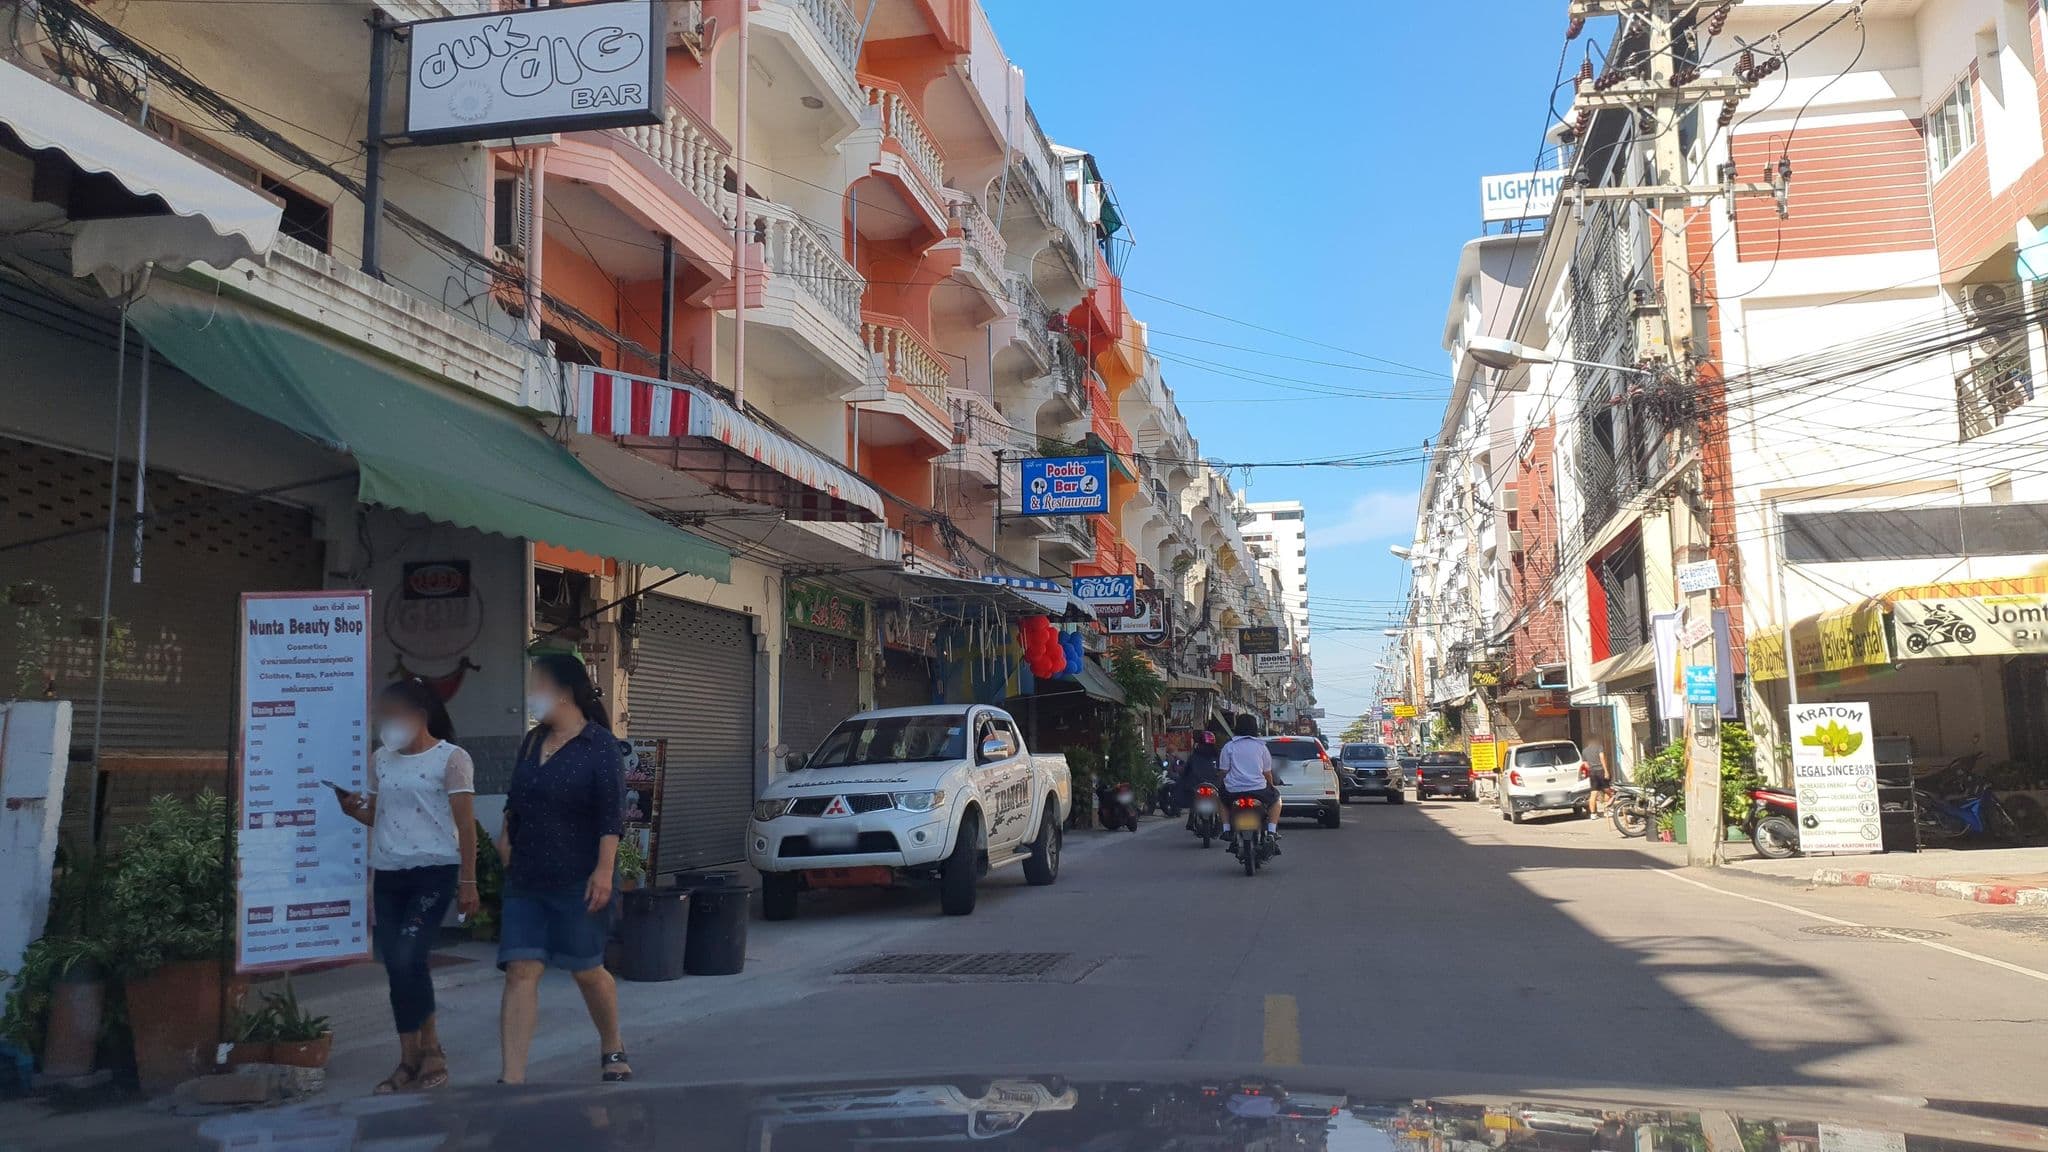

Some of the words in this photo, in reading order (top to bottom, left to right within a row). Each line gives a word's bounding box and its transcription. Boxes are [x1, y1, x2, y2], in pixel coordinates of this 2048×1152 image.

[571, 83, 642, 109] BAR
[1046, 461, 1086, 478] Pookie
[1054, 479, 1079, 493] Bar
[1031, 495, 1041, 510] &
[1043, 493, 1101, 511] Restaurant
[250, 619, 284, 636] Nunta
[290, 618, 330, 637] Beauty
[334, 617, 363, 636] Shop
[287, 643, 328, 651] Cosmetics
[1796, 706, 1863, 724] KRATOM
[1796, 765, 1827, 777] LEGAL
[1827, 764, 1855, 776] SINCE
